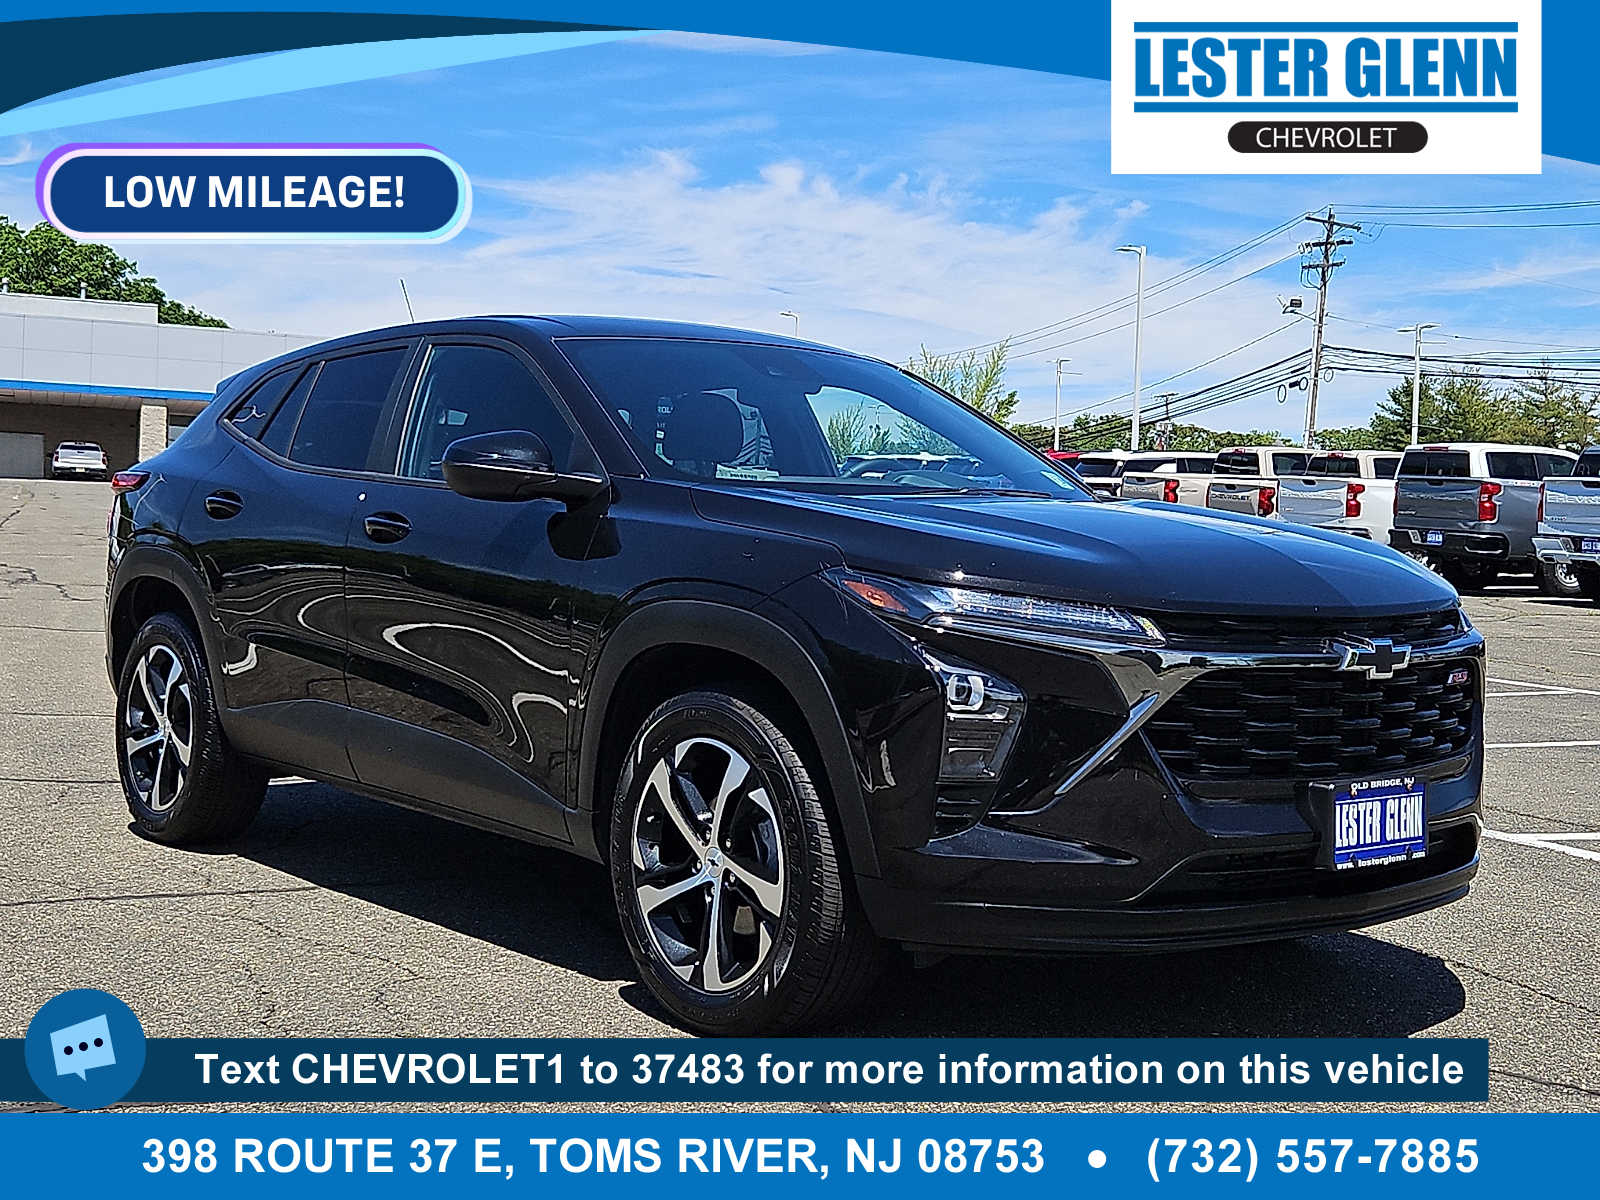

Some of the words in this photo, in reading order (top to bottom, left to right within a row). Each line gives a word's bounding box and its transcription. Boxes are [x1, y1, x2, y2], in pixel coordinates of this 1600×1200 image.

[1350, 781, 1369, 791] OLD
[1371, 778, 1403, 789] BRIDGE,
[1404, 776, 1415, 785] NJ
[1335, 800, 1382, 849] LESTER
[1385, 795, 1423, 842] GLENN
